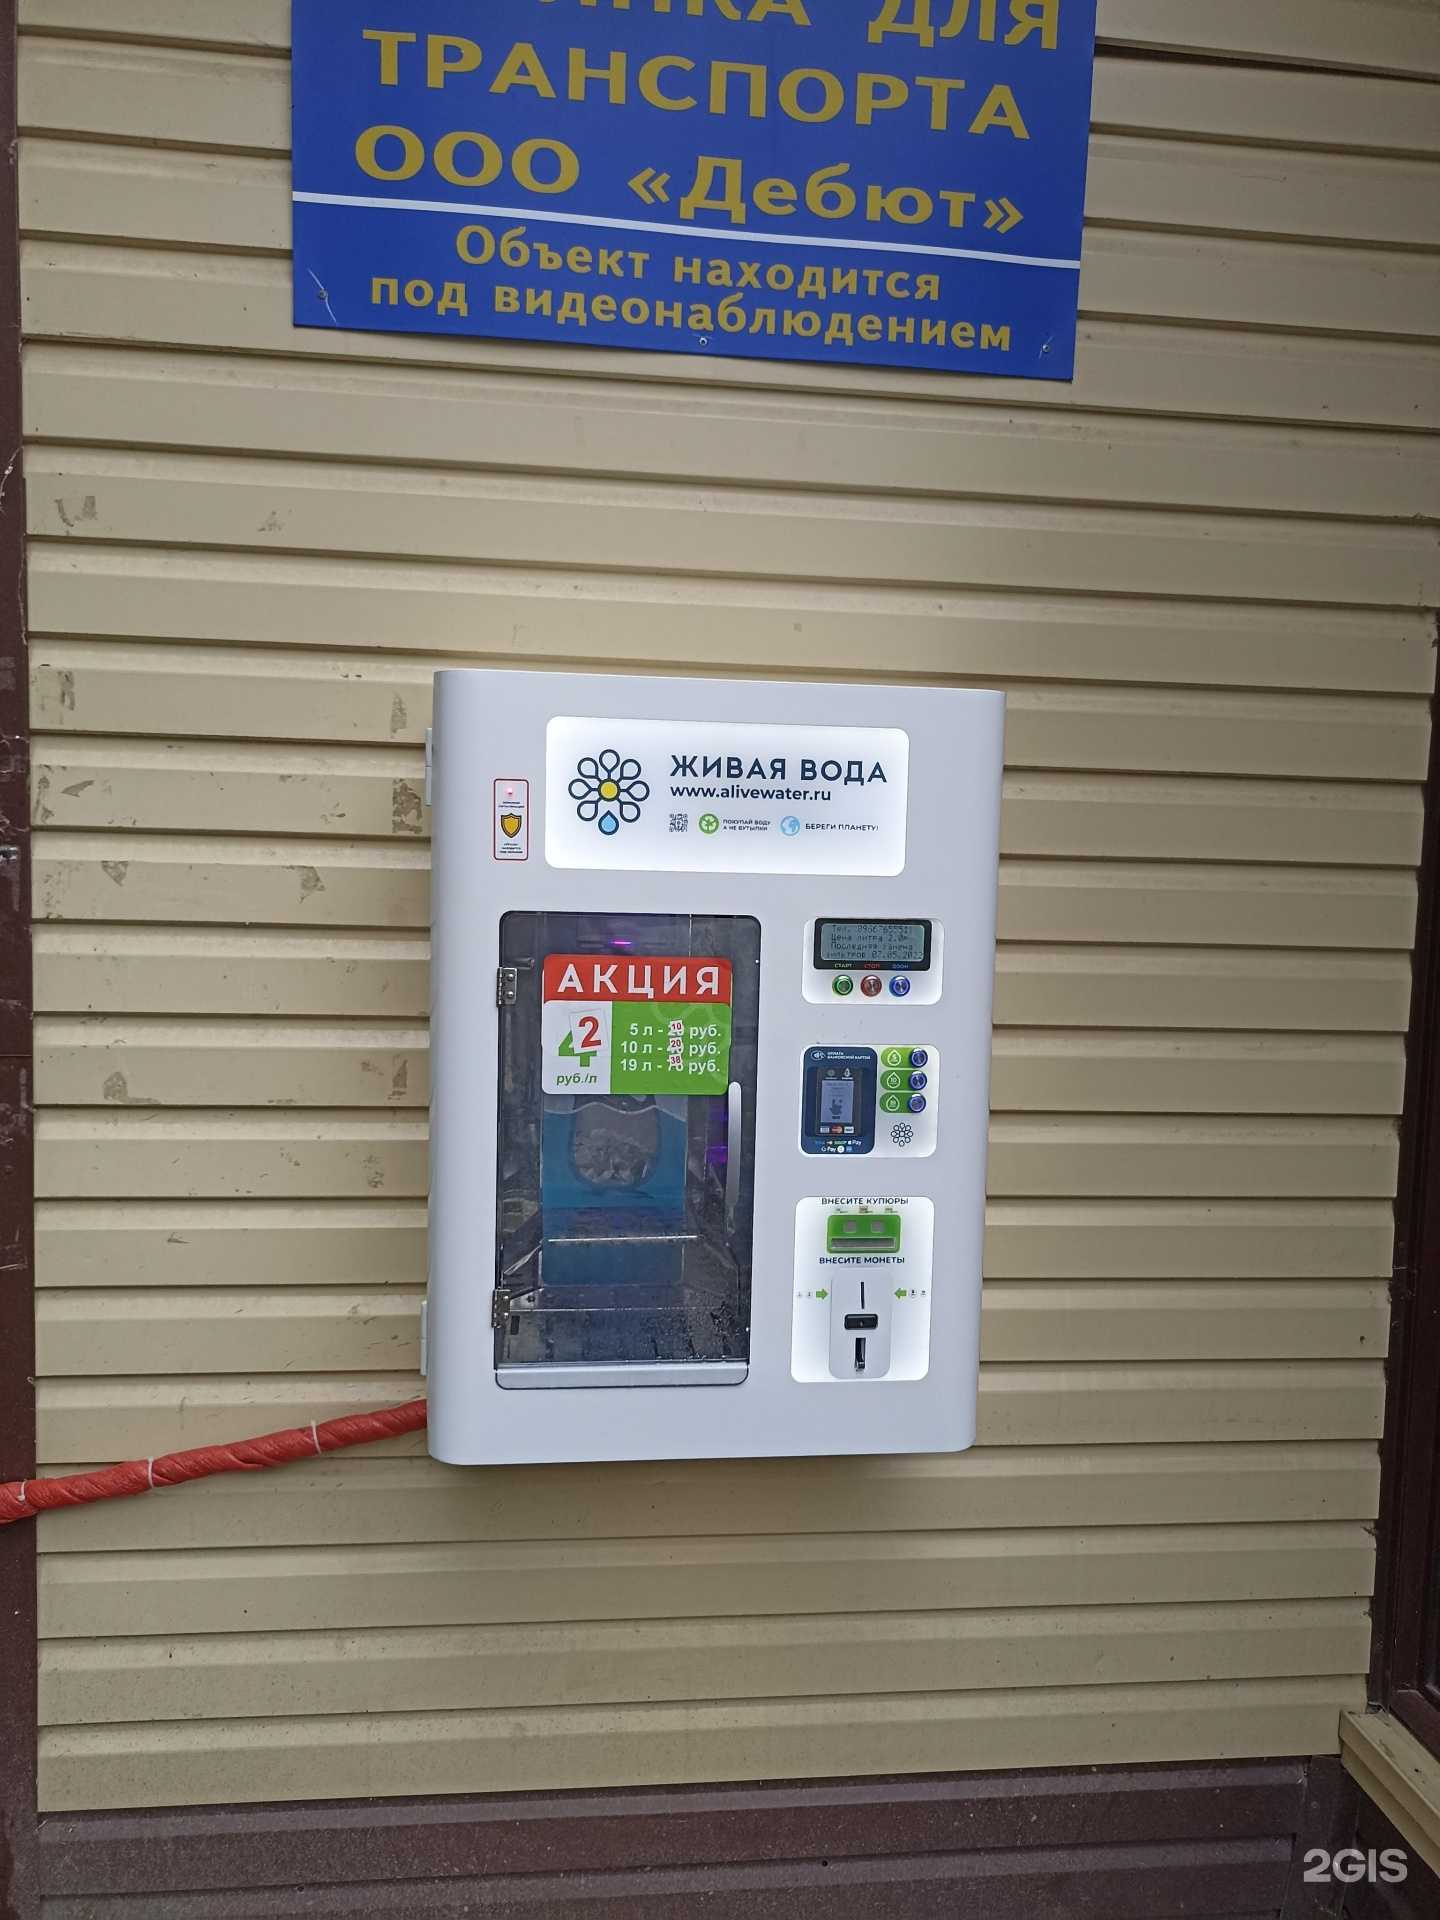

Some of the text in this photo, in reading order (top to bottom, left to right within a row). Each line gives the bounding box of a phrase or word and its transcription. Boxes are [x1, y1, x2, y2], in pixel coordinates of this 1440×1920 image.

[363, 31, 1029, 139] ТРАНСПОРТА
[355, 126, 1025, 233] ООО «Дебют»
[457, 226, 941, 301] Объект находится
[373, 276, 1012, 352] под видеонаблюдением
[670, 754, 888, 786] ЖИВАЯ ВОДА
[670, 784, 832, 802] www.alivewater.ru
[805, 823, 837, 831] БЕРЕГИ
[557, 963, 719, 999] АКЦИЯ
[578, 1016, 602, 1049] 2
[629, 1023, 639, 1036] 5
[643, 1026, 653, 1036] л
[671, 1022, 682, 1030] 10
[689, 1024, 721, 1040] руб.
[620, 1041, 638, 1054] 10
[643, 1043, 652, 1054] л
[671, 1040, 682, 1048] 20
[689, 1041, 721, 1057] руб.
[620, 1058, 638, 1071] 19
[641, 1061, 652, 1071] л
[688, 1059, 720, 1075] руб.
[556, 1072, 598, 1087] руб./л
[821, 1197, 909, 1205] ВНЕСИТЕ КУПЮРЫ
[819, 1256, 861, 1264] ВНЕСИТЕ
